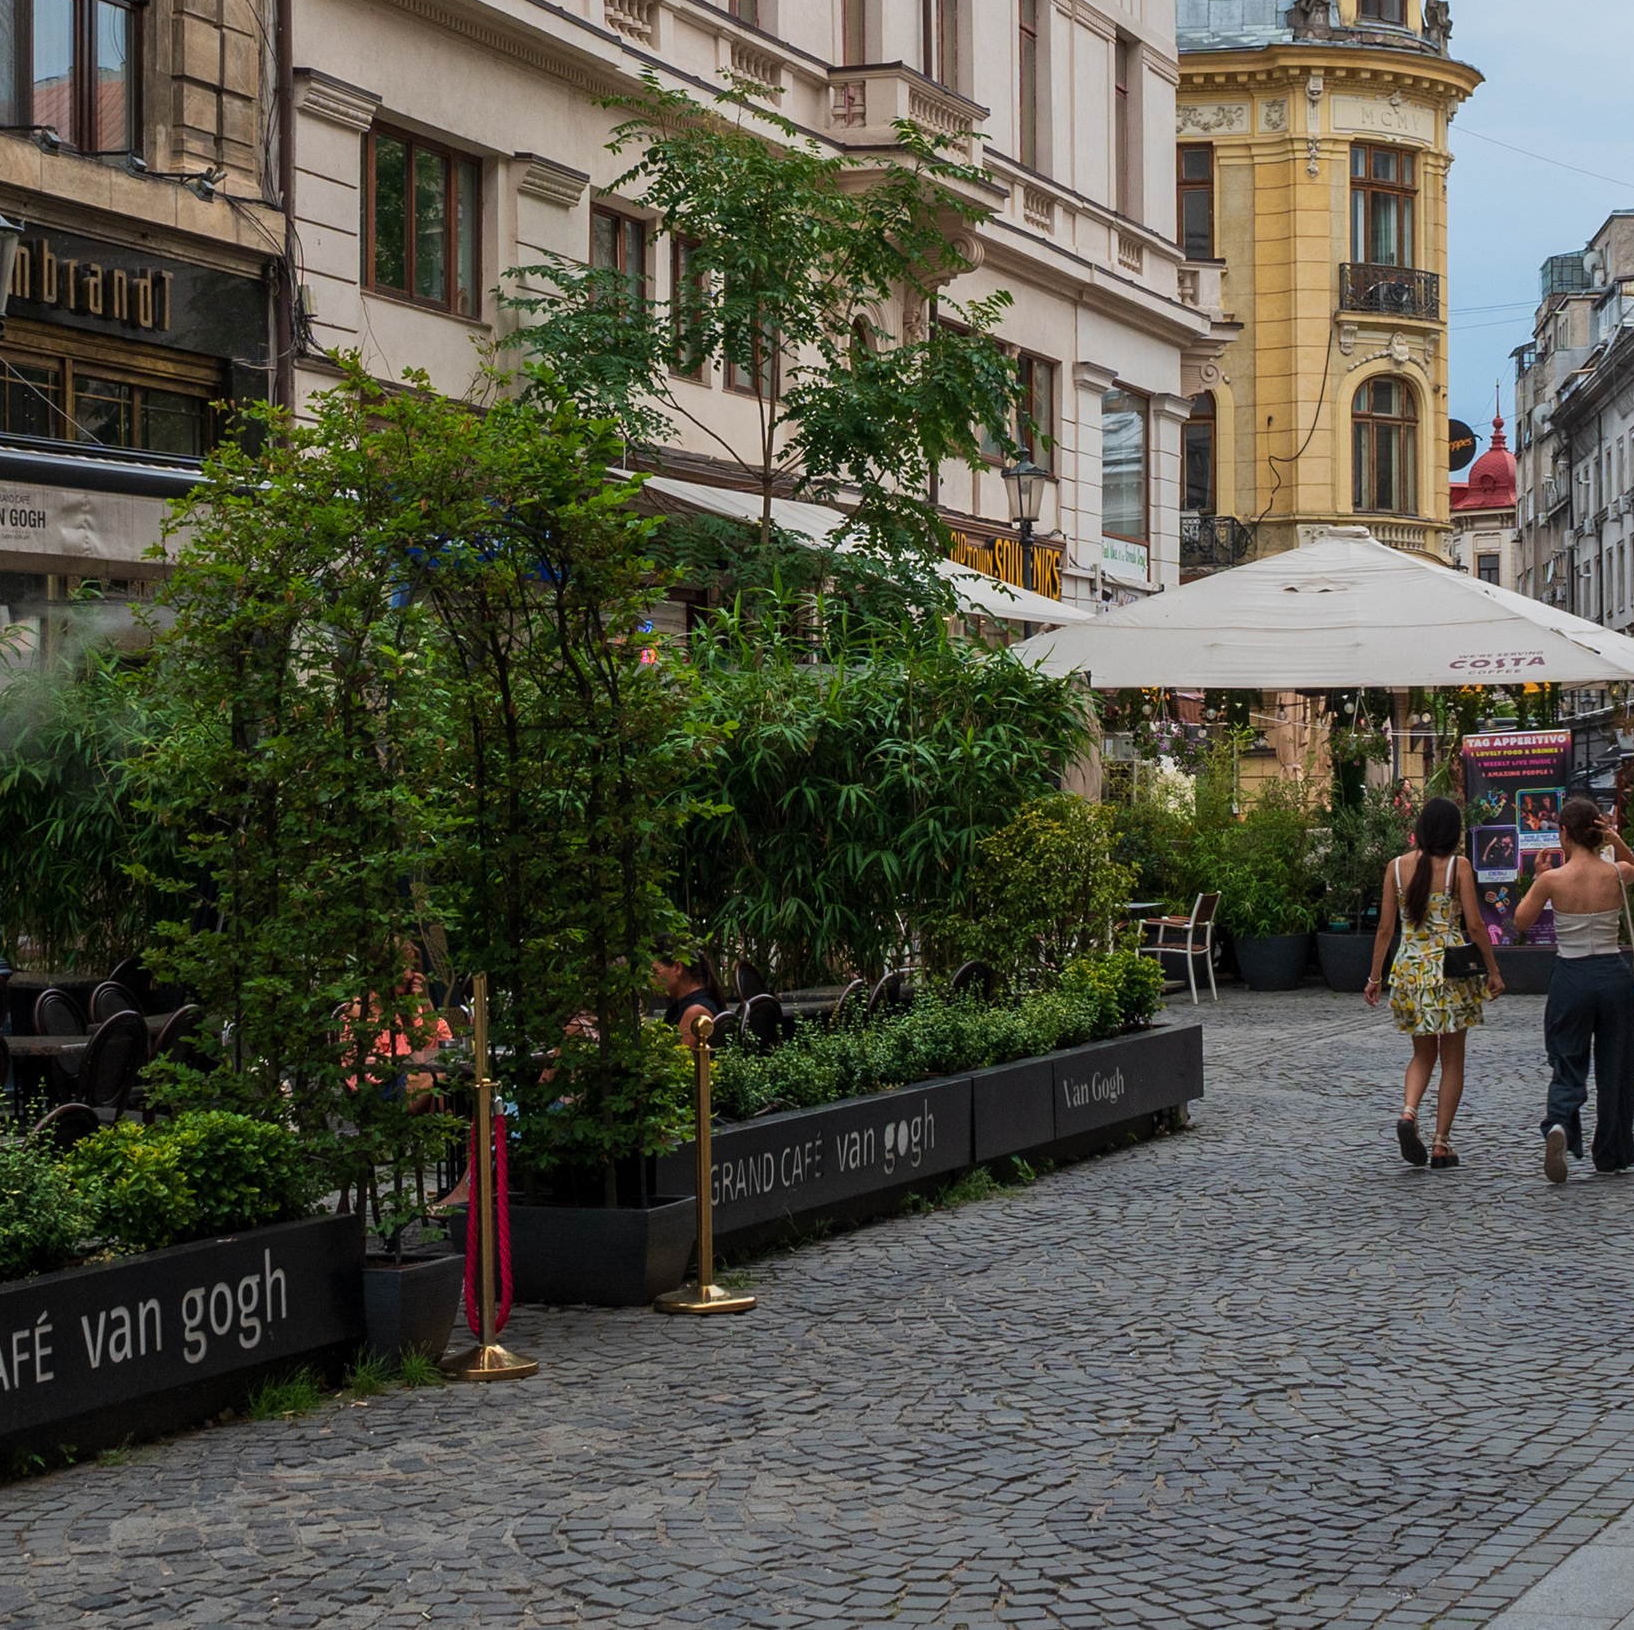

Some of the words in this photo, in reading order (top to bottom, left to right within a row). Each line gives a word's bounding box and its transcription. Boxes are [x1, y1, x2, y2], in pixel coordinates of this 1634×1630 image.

[8, 238, 174, 331] mbrandT
[9, 508, 46, 528] GOGH
[1449, 656, 1546, 670] COSTA
[1497, 650, 1544, 658] SERVING
[1467, 738, 1490, 748] TAG
[1493, 734, 1566, 747] APPERITIVO
[1091, 1064, 1126, 1105] Gogh
[710, 1152, 775, 1207] GRAND
[780, 1131, 824, 1188] CAFÉ
[836, 1126, 875, 1172] van
[884, 1098, 936, 1175] gogh
[81, 1297, 163, 1370] van
[181, 1248, 289, 1365] gogh
